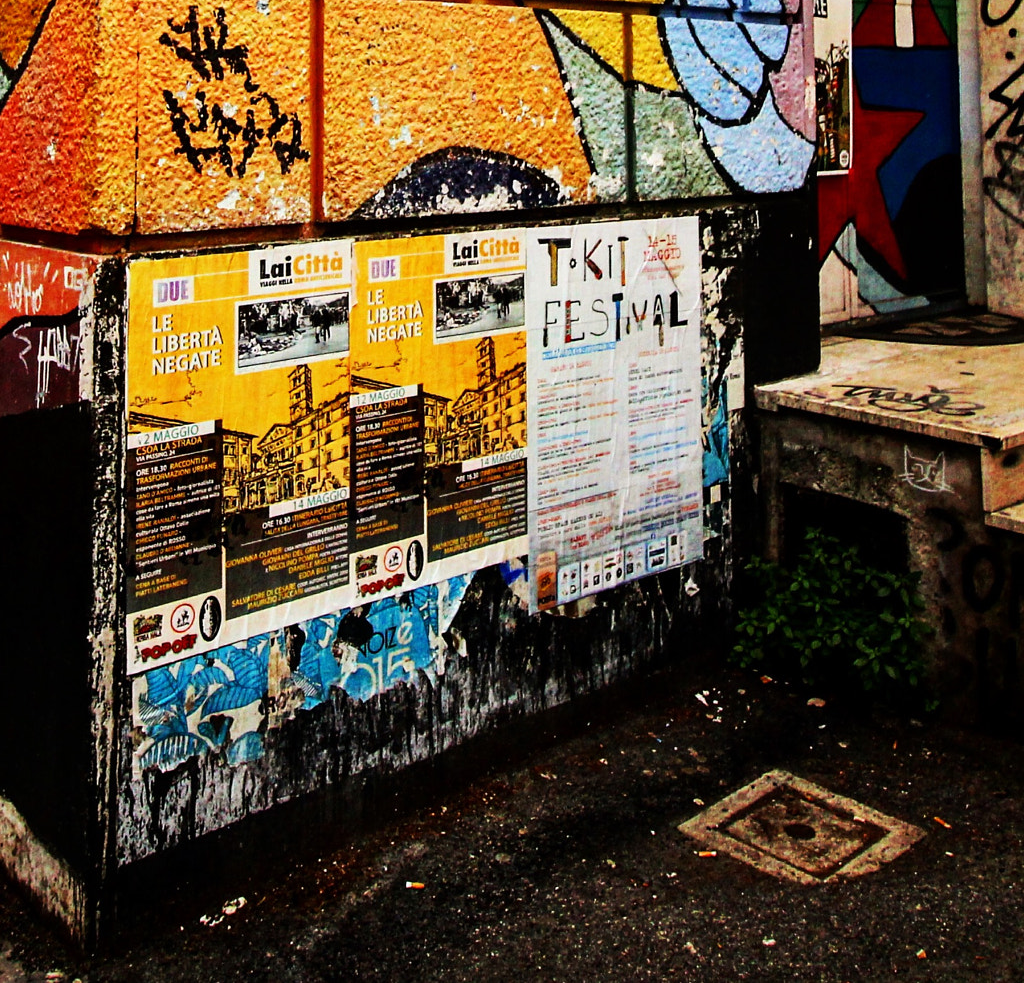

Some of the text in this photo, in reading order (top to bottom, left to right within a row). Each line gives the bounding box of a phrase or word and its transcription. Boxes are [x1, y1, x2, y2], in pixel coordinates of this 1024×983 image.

[453, 237, 519, 260] LaiCittà
[260, 251, 342, 279] LaiCittà
[371, 259, 396, 279] DUE
[157, 280, 189, 303] DUE
[260, 279, 277, 287] VIAGGI
[368, 289, 384, 305] LE
[368, 300, 424, 325] LIBERTÀ
[542, 291, 688, 347] FESTIVAL
[152, 314, 173, 333] LE
[367, 322, 422, 343] NEGATE
[152, 325, 223, 354] LIBERTÀ
[152, 349, 222, 376] NEGATE
[357, 388, 405, 404] 12 MAGGIO
[356, 406, 373, 414] CSOA
[384, 398, 407, 408] STRADA
[154, 425, 199, 442] MAGGIO
[136, 436, 202, 456] CSOA LA STRADA
[136, 468, 149, 477] ORE
[170, 458, 200, 469] RACCONTI
[481, 449, 524, 467] 14 MAGGIO
[136, 462, 216, 485] TRASFORMAZIONI URBANE
[294, 500, 304, 510] 14
[307, 489, 347, 507] MAGGIO
[262, 520, 274, 529] ORE
[276, 516, 291, 526] 16.30
[307, 523, 348, 538] INTERVERRANNO
[226, 553, 258, 568] GIOVANNA
[262, 553, 291, 566] GIOVANNI
[305, 543, 325, 554] GRILLO
[299, 553, 319, 563] POMPA
[289, 562, 312, 574] DANIELE
[314, 555, 334, 567] MIGLIO
[299, 569, 315, 579] EDDA
[316, 565, 329, 575] BILLI
[156, 576, 170, 584] BASE
[232, 590, 265, 607] SALVATORE
[275, 582, 296, 594] CESARE
